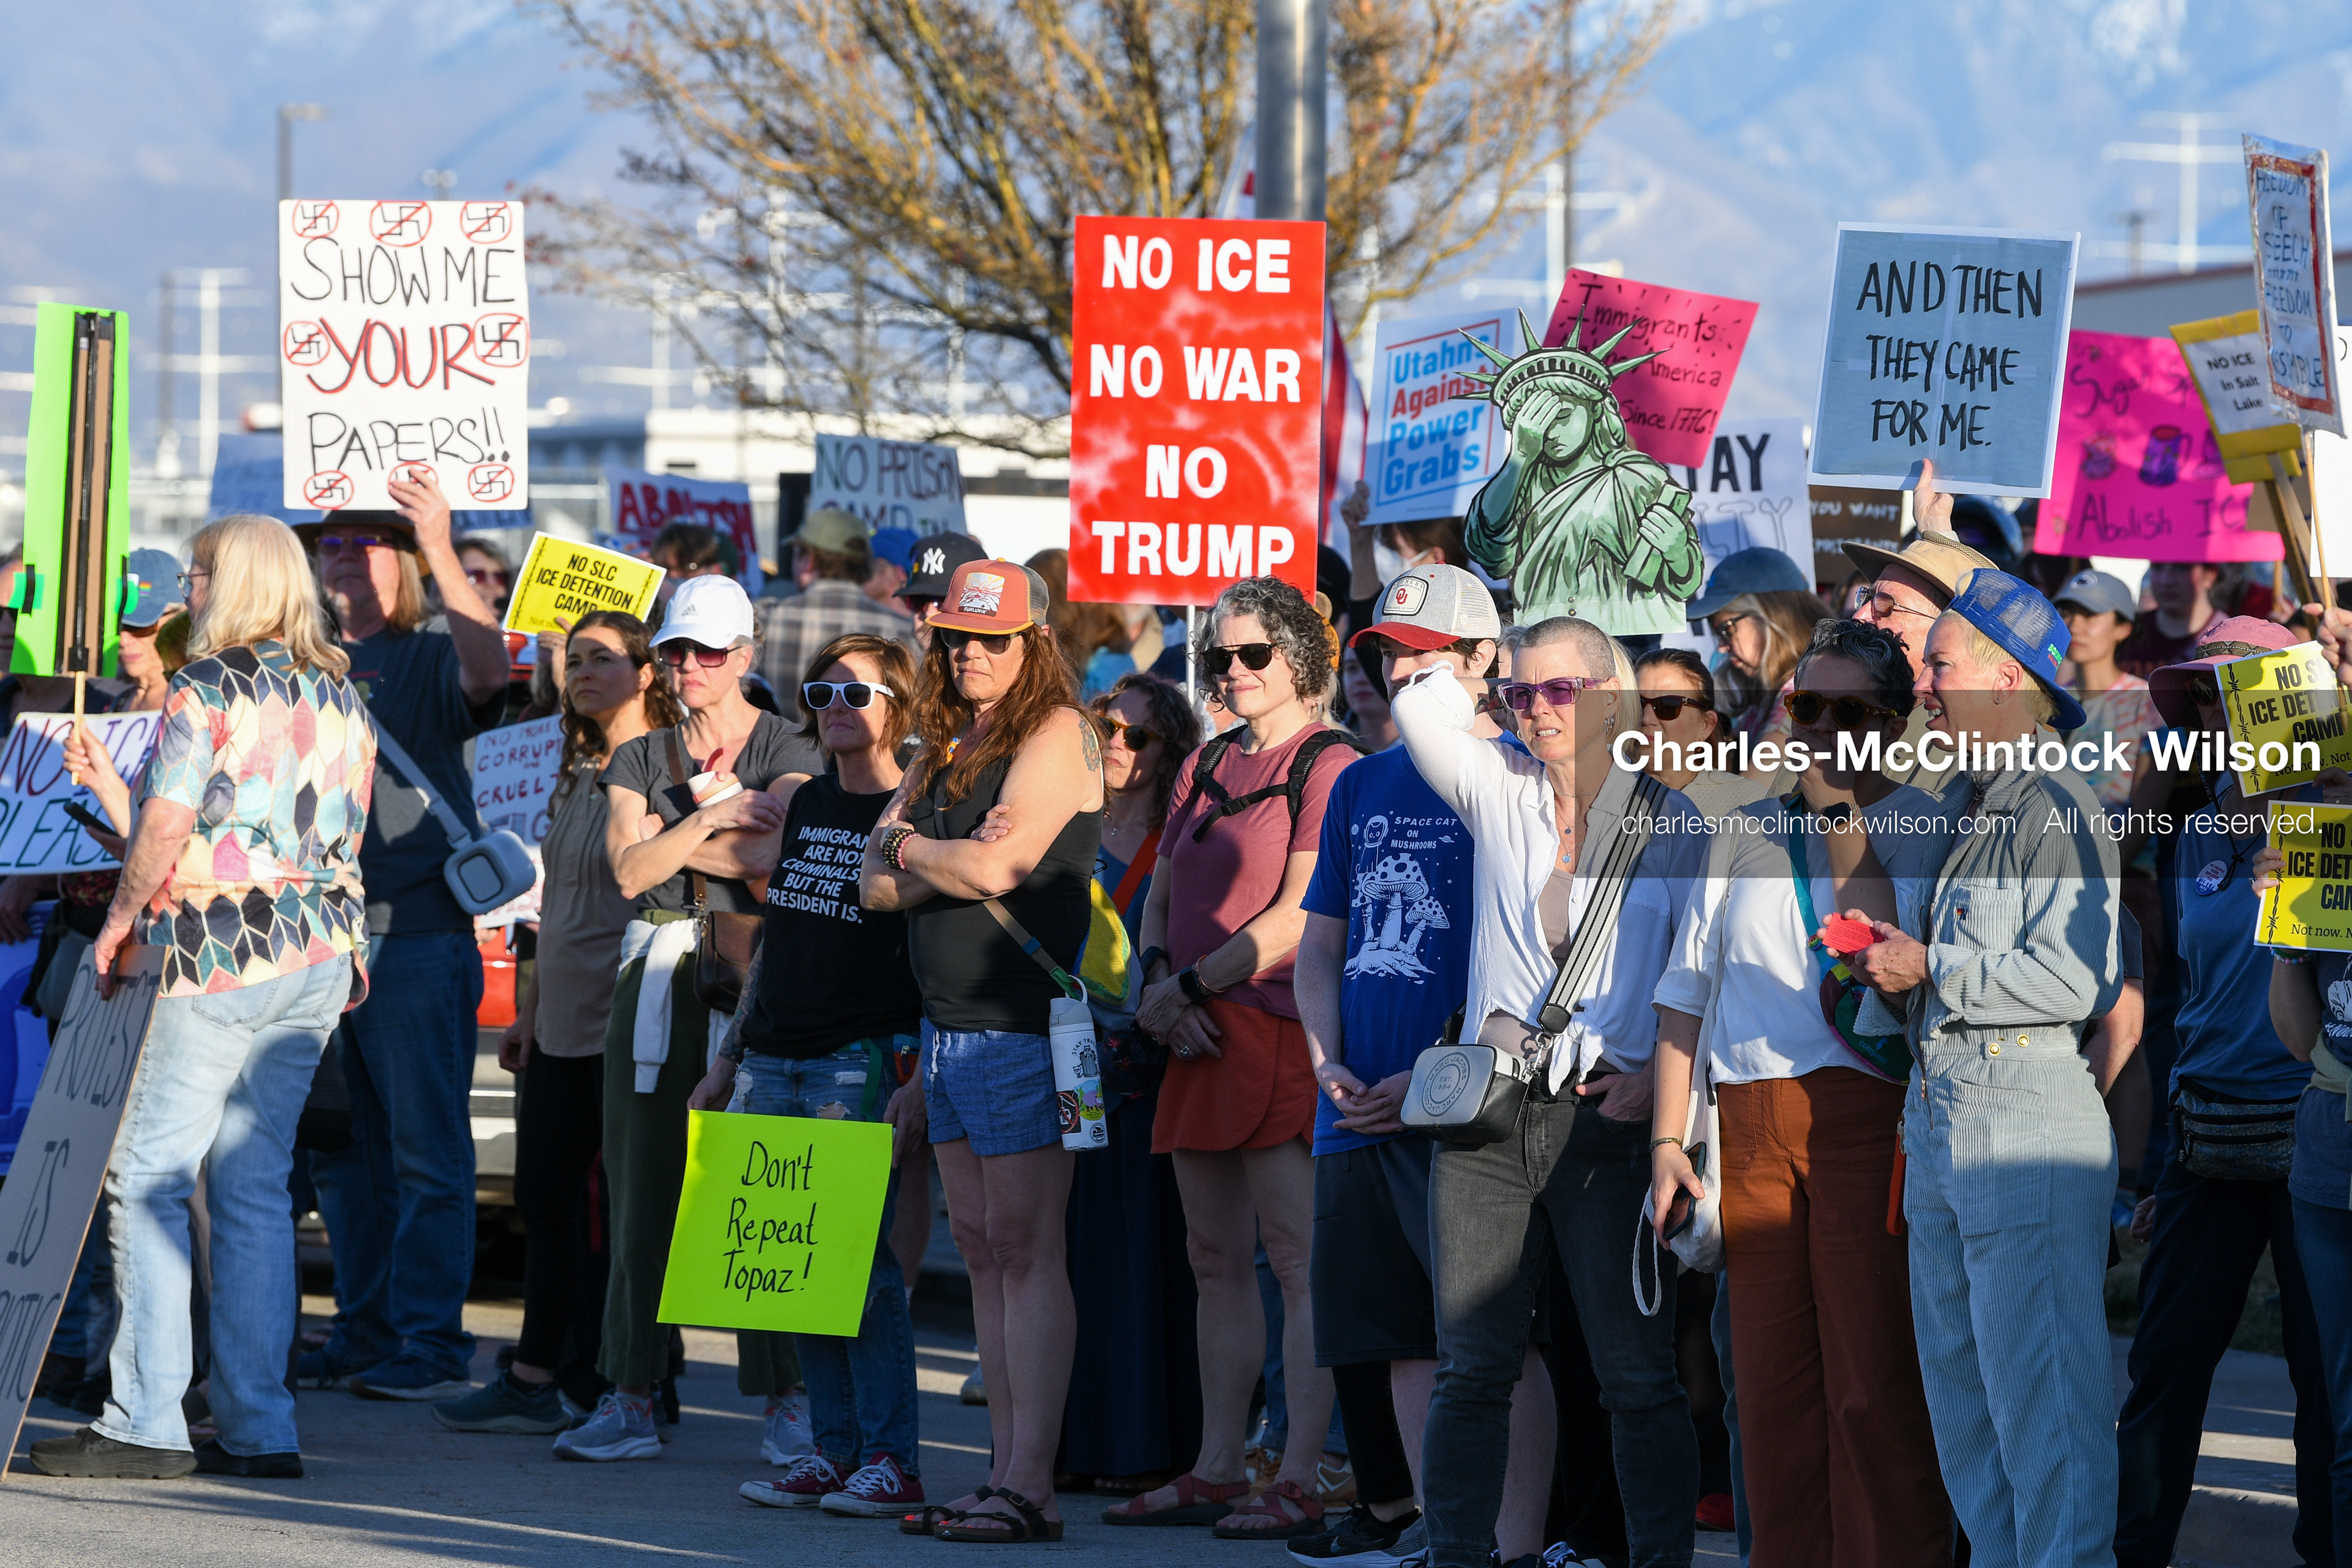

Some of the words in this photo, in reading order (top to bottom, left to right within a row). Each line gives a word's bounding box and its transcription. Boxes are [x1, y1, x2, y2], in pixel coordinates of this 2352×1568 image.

[292, 237, 431, 306] SHOW
[445, 246, 515, 307] ME
[1102, 234, 1173, 290] NO
[1197, 238, 1291, 293] ICE
[1856, 260, 1945, 318] AND
[1952, 263, 2043, 319] THEN
[306, 317, 495, 393] YOUR
[1394, 334, 1491, 385] Utahns
[1865, 334, 1940, 393] THEY
[1945, 341, 2021, 392] CAME
[2207, 356, 2230, 371] NO
[2231, 352, 2256, 368] ICE
[1089, 343, 1164, 399] NO
[1183, 346, 1301, 403] WAR
[2220, 378, 2235, 392] In
[2236, 374, 2261, 390] Salt
[1391, 363, 1488, 421] Against
[2233, 397, 2264, 412] Lake
[1388, 403, 1486, 457] Power
[1621, 399, 1667, 429] Since
[1871, 398, 1929, 447] FOR
[1939, 402, 1992, 452] ME.
[307, 407, 511, 475] PAPERS!!
[815, 440, 869, 492] NO
[1145, 444, 1228, 500] NO
[1384, 442, 1482, 497] Grabs
[1686, 433, 1771, 493] AY
[1848, 501, 1900, 522] WANT
[2076, 491, 2173, 543] Abolish
[2194, 494, 2250, 539] IC
[1091, 519, 1295, 578] TRUMP
[567, 553, 589, 572] NO
[589, 560, 618, 581] SLC
[535, 567, 560, 587] ICE
[559, 573, 634, 610] DETENTION
[2274, 663, 2302, 691] NO
[2305, 659, 2337, 684] SL
[2247, 697, 2281, 726] ICE
[483, 729, 513, 748] NO
[2330, 751, 2351, 764] Not
[1394, 816, 1433, 826] SPACE
[1435, 818, 1458, 826] CAT
[1406, 829, 1419, 839] ON
[2321, 822, 2346, 850] NO
[803, 844, 835, 862] ARE
[1390, 839, 1437, 850] MUSHROOMS
[2287, 851, 2315, 877] ICE
[783, 872, 816, 891] BUT
[814, 878, 844, 898] THE
[767, 887, 840, 918] PRESIDENT
[840, 903, 863, 924] IS.
[2290, 923, 2313, 937] Not
[2314, 925, 2343, 939] now.
[1071, 1041, 1082, 1055] STAY
[1859, 1041, 1887, 1065] cotopaxi
[1429, 1058, 1450, 1081] MARC
[1450, 1056, 1467, 1080] JACOBS
[1423, 1087, 1440, 1112] JACOBS
[1442, 1086, 1462, 1110] MARC
[741, 1140, 814, 1192] Don't
[726, 1196, 819, 1255] Repeat
[722, 1248, 813, 1303] Topaz!
